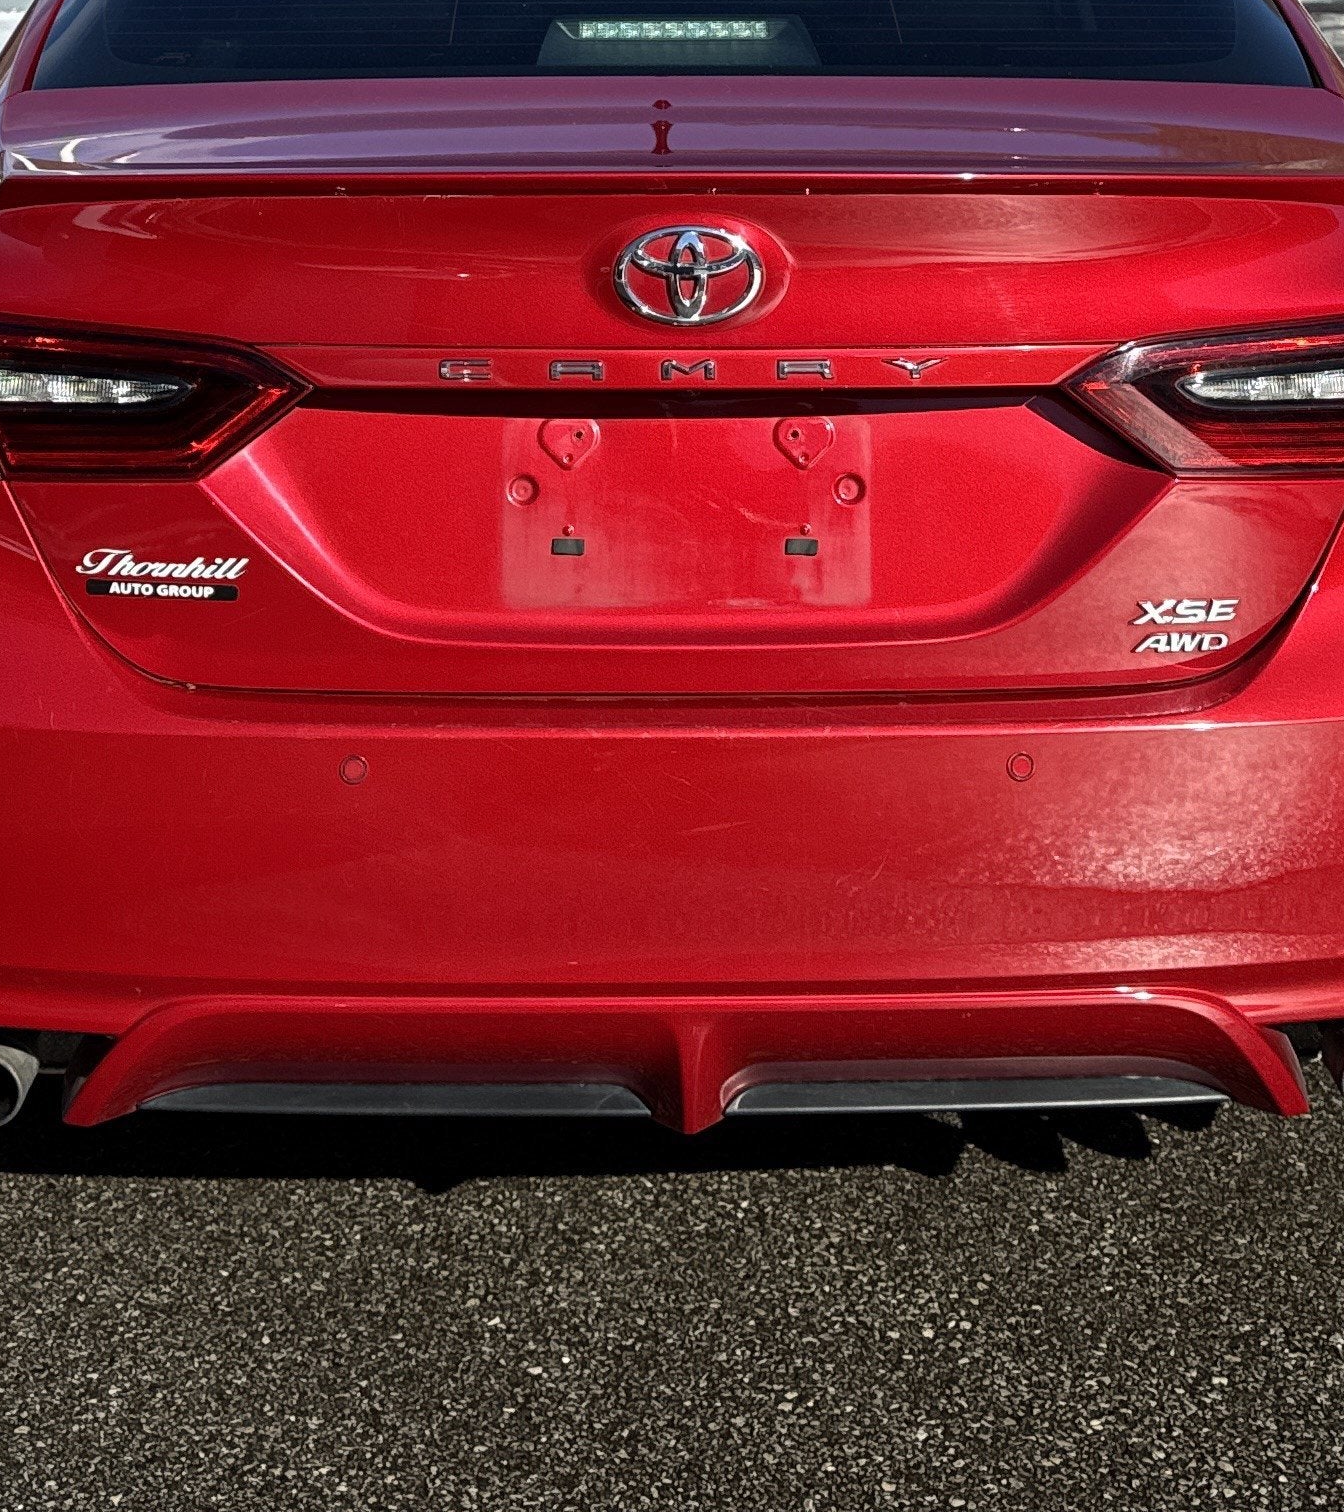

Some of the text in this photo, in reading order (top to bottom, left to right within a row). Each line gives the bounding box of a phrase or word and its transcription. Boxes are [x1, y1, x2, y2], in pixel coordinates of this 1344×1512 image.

[438, 357, 950, 382] CAMRY
[75, 548, 250, 580] Thornhill
[109, 581, 215, 599] AUTO GROUP
[1129, 598, 1240, 625] XSE
[1131, 632, 1229, 653] AWD
